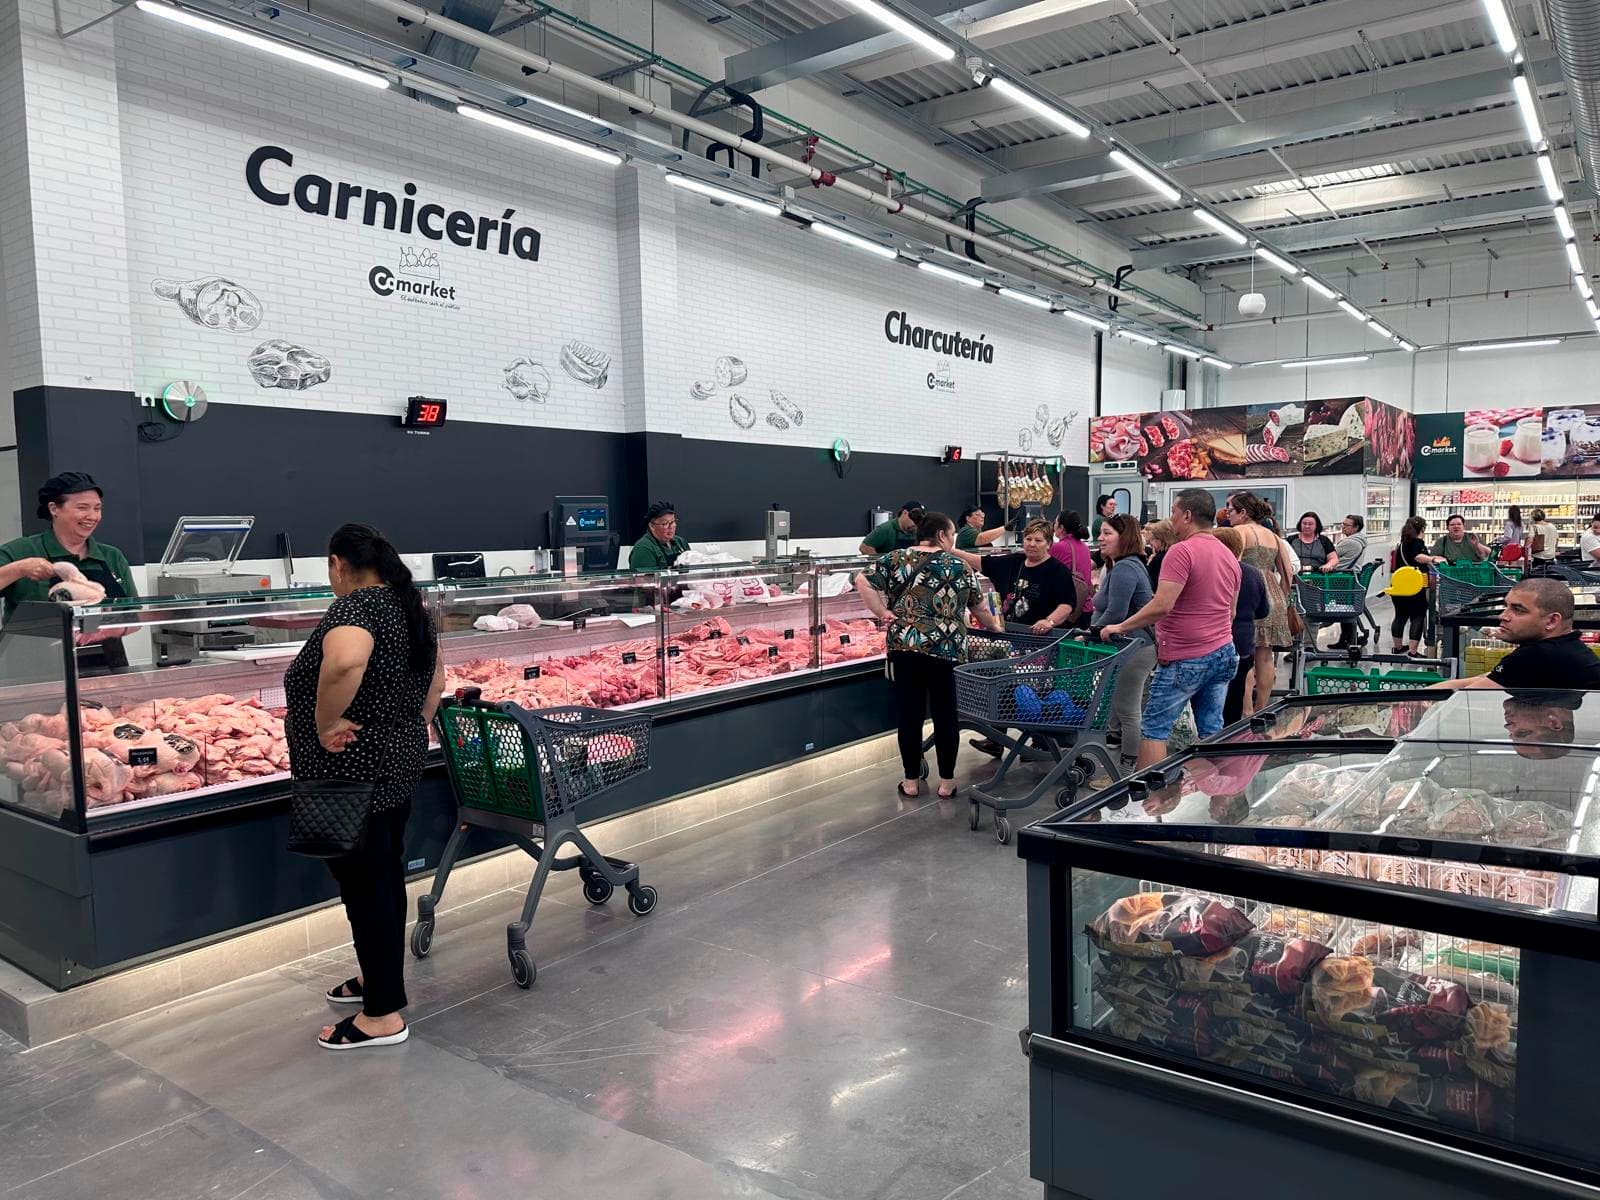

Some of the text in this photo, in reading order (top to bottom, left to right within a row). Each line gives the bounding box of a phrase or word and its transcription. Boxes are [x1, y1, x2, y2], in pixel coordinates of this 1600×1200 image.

[246, 145, 541, 261] Carnicería
[885, 310, 994, 364] Charcutería
[417, 404, 440, 421] 38
